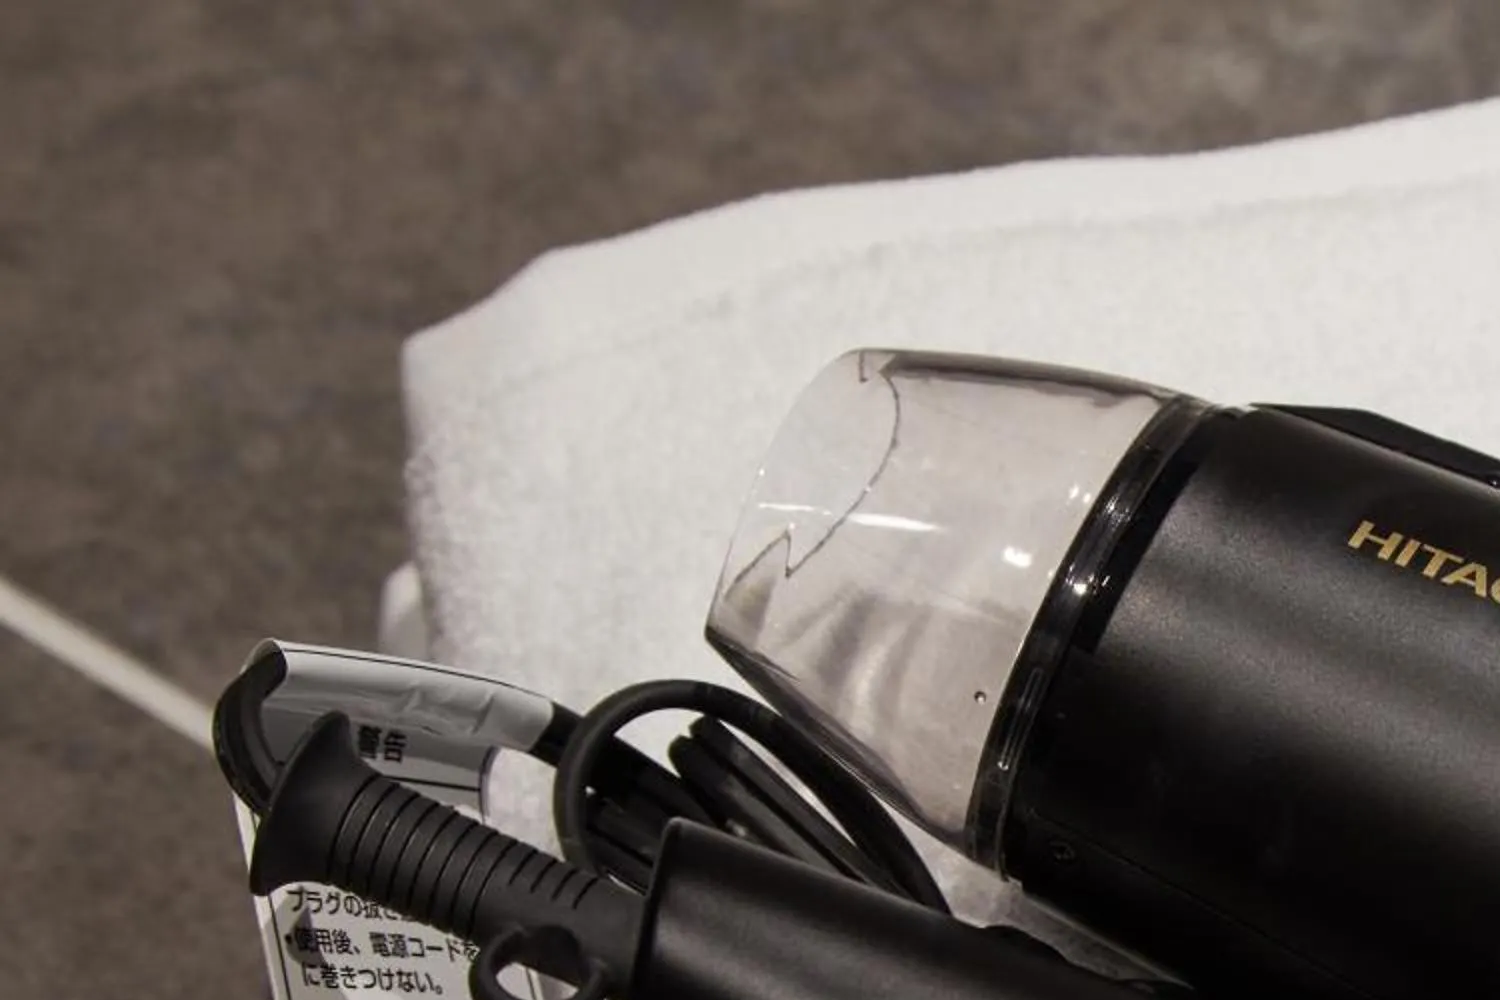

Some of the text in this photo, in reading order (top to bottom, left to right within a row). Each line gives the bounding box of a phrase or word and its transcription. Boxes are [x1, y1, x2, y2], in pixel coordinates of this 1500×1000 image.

[302, 962, 443, 995] に巻きつけない。
